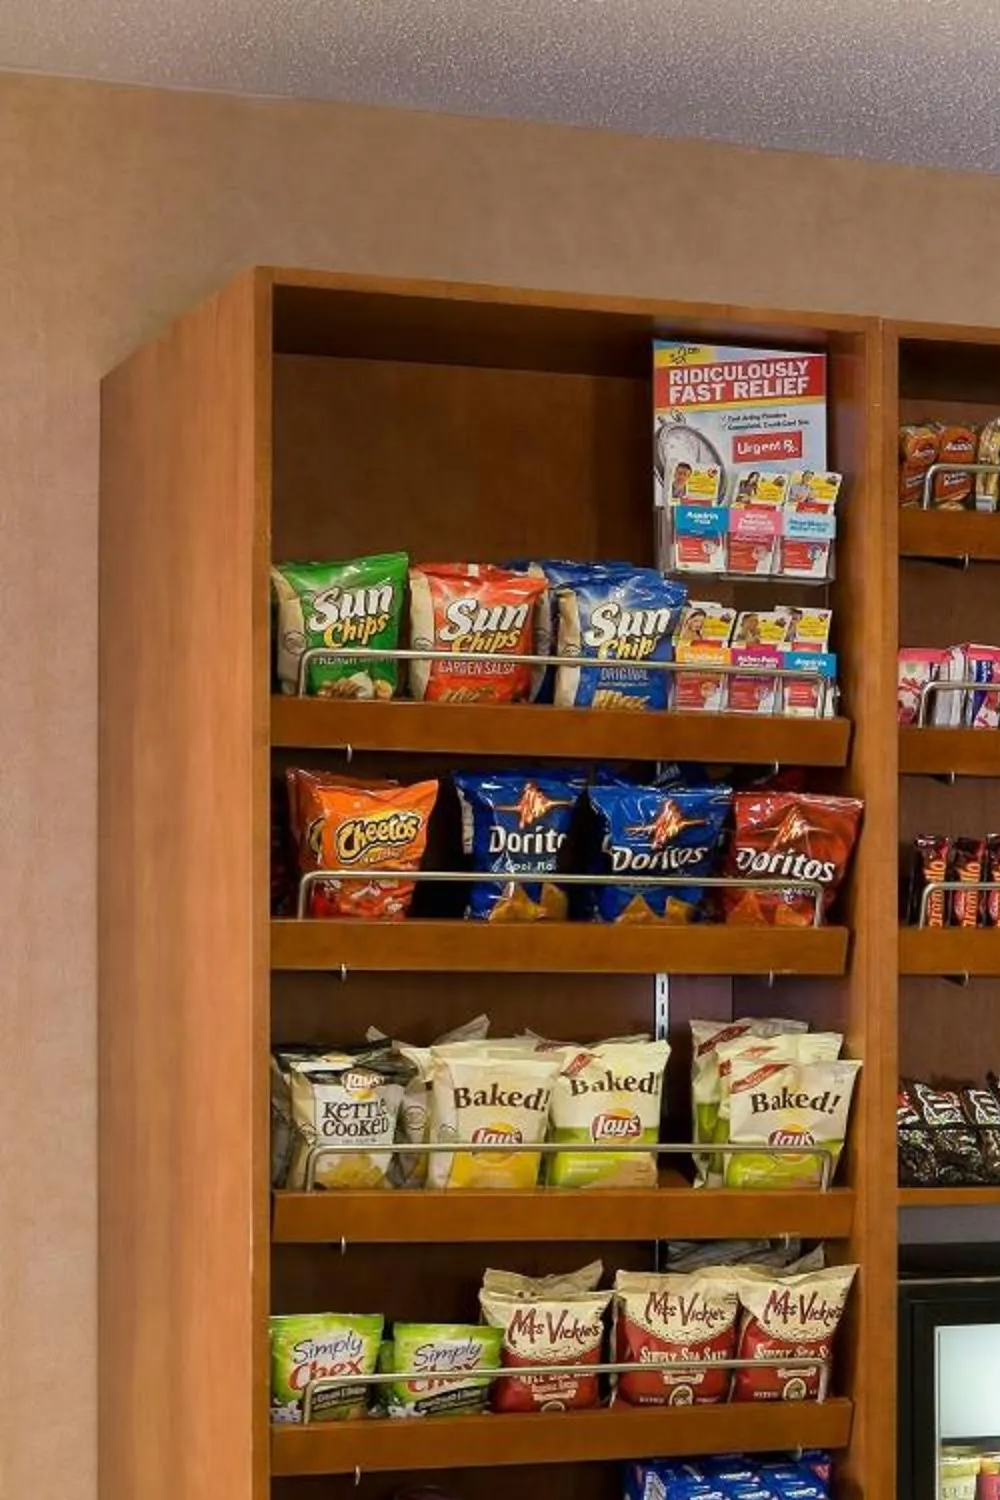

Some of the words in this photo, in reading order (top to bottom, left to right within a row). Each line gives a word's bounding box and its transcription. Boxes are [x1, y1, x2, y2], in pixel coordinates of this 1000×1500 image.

[669, 361, 809, 385] RIDICULOUSLY
[669, 384, 725, 404] FAST
[733, 377, 809, 399] RELIEF
[309, 584, 393, 631] Sun
[440, 598, 529, 641] Sun
[323, 612, 391, 648] Chips
[586, 601, 671, 646] Sun
[452, 628, 520, 654] Chips
[337, 813, 420, 860] Cheetos
[489, 826, 567, 853] Dorit
[612, 846, 708, 871] Doritos
[736, 847, 836, 883] Doritos
[453, 1082, 551, 1111] Baked!
[570, 1070, 659, 1096] Baked!
[751, 1086, 842, 1115] Baked!
[293, 1331, 363, 1363] Simply
[414, 1338, 482, 1367] Simply
[289, 1356, 363, 1390] Chex
